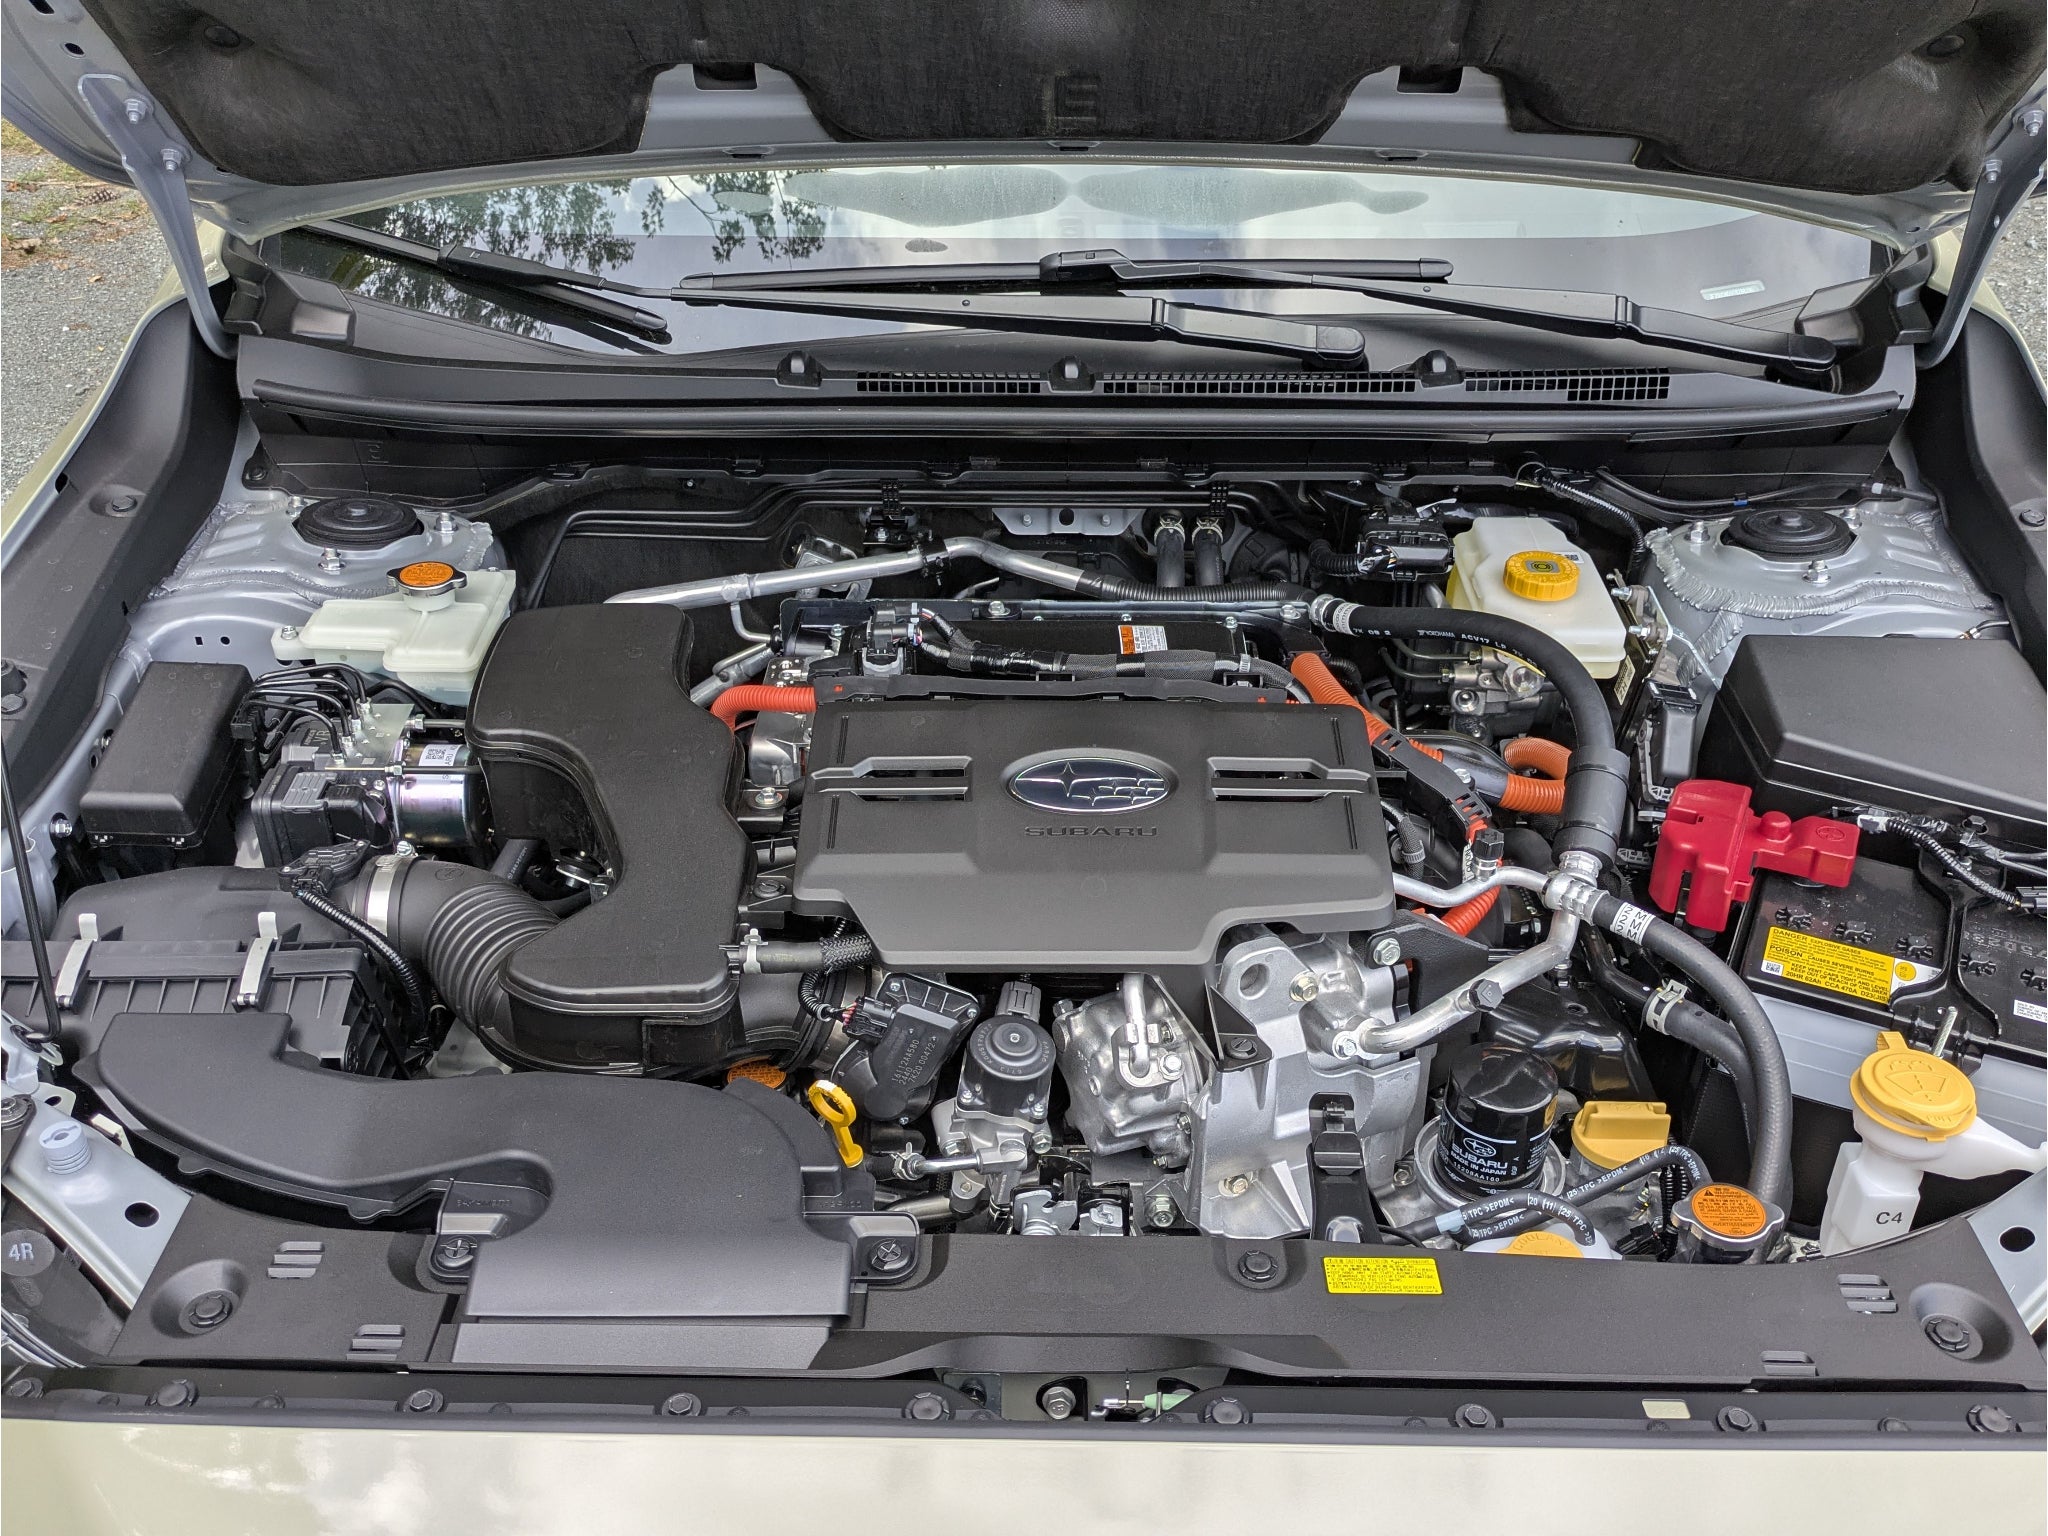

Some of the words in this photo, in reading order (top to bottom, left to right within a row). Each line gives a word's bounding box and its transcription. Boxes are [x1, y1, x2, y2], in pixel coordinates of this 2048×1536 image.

[1461, 634, 1490, 644] ACV17
[1024, 826, 1157, 837] SUBARU
[1773, 928, 1808, 941] DANGER
[1810, 939, 1841, 950] EXPLOSIVE
[1770, 944, 1803, 958] POISON
[1808, 956, 1830, 964] CAUSES
[1832, 961, 1854, 971] SEVERE
[1792, 962, 1806, 970] KEEP
[1791, 966, 1806, 974] KEEP
[1829, 976, 1849, 986] REACH
[1858, 984, 1888, 996] CHILDREN
[1824, 981, 1840, 990] CCA
[892, 1040, 920, 1082] 16112AA580
[1450, 1150, 1469, 1166] MADE
[1470, 1163, 1478, 1171] IN
[1480, 1166, 1507, 1176] JAPAN
[1452, 1143, 1508, 1170] SUBARU
[1453, 1161, 1500, 1182] 15208AA160
[1580, 1181, 1596, 1193] TPC
[1598, 1166, 1628, 1184] >EPDM<
[1468, 1207, 1483, 1218] TPC
[1485, 1196, 1514, 1212] >EPDM<
[1573, 1216, 1586, 1231] TPC
[1494, 1214, 1525, 1231] >EPDM<
[1876, 1212, 1902, 1224] C4
[8, 1242, 34, 1262] 4R
